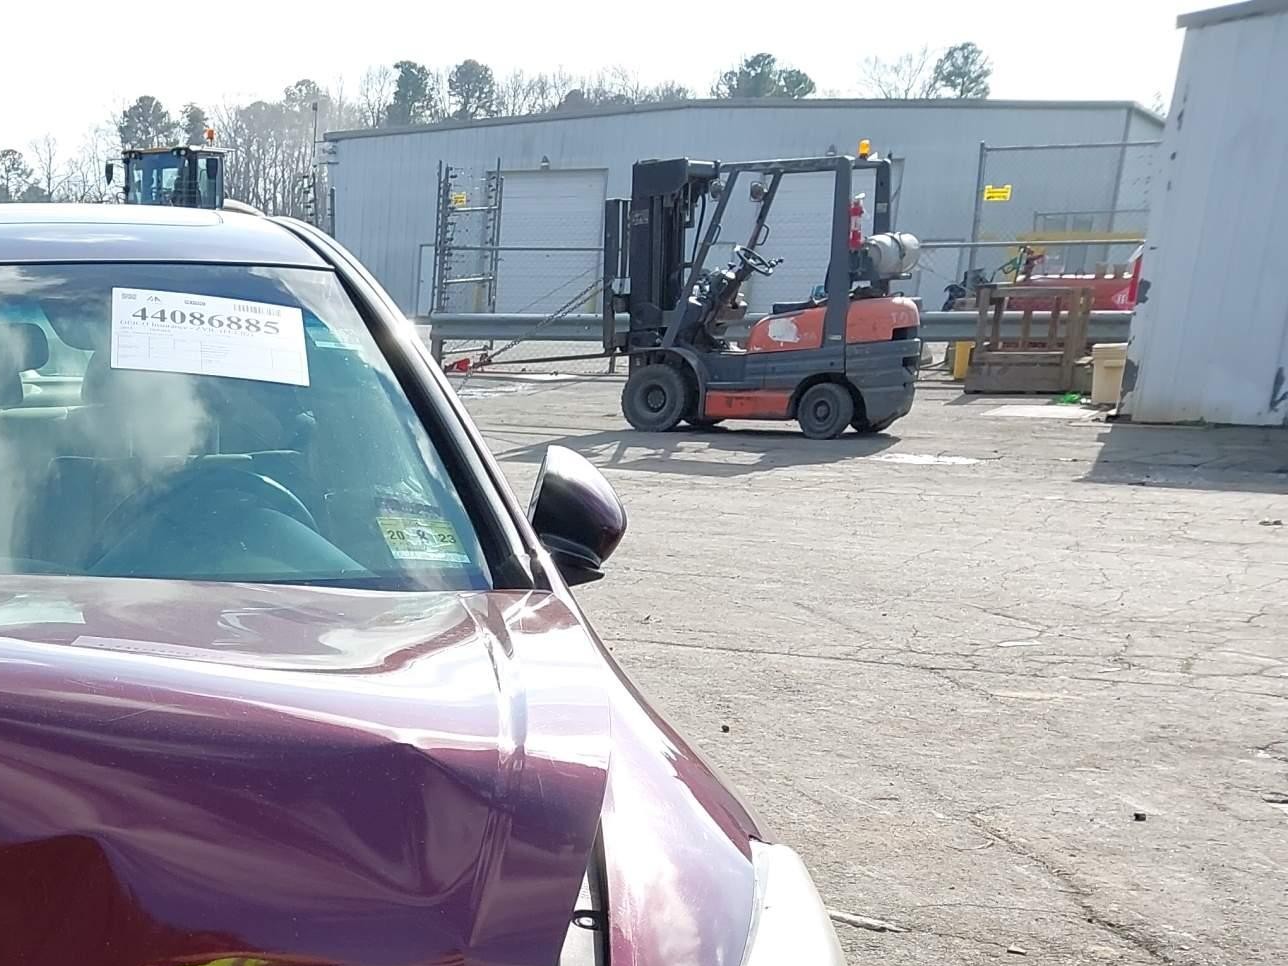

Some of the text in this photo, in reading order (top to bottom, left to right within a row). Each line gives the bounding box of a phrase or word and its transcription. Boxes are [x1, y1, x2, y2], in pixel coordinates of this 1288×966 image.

[131, 306, 280, 335] 44086885
[387, 530, 405, 540] 20
[438, 533, 457, 544] 23
